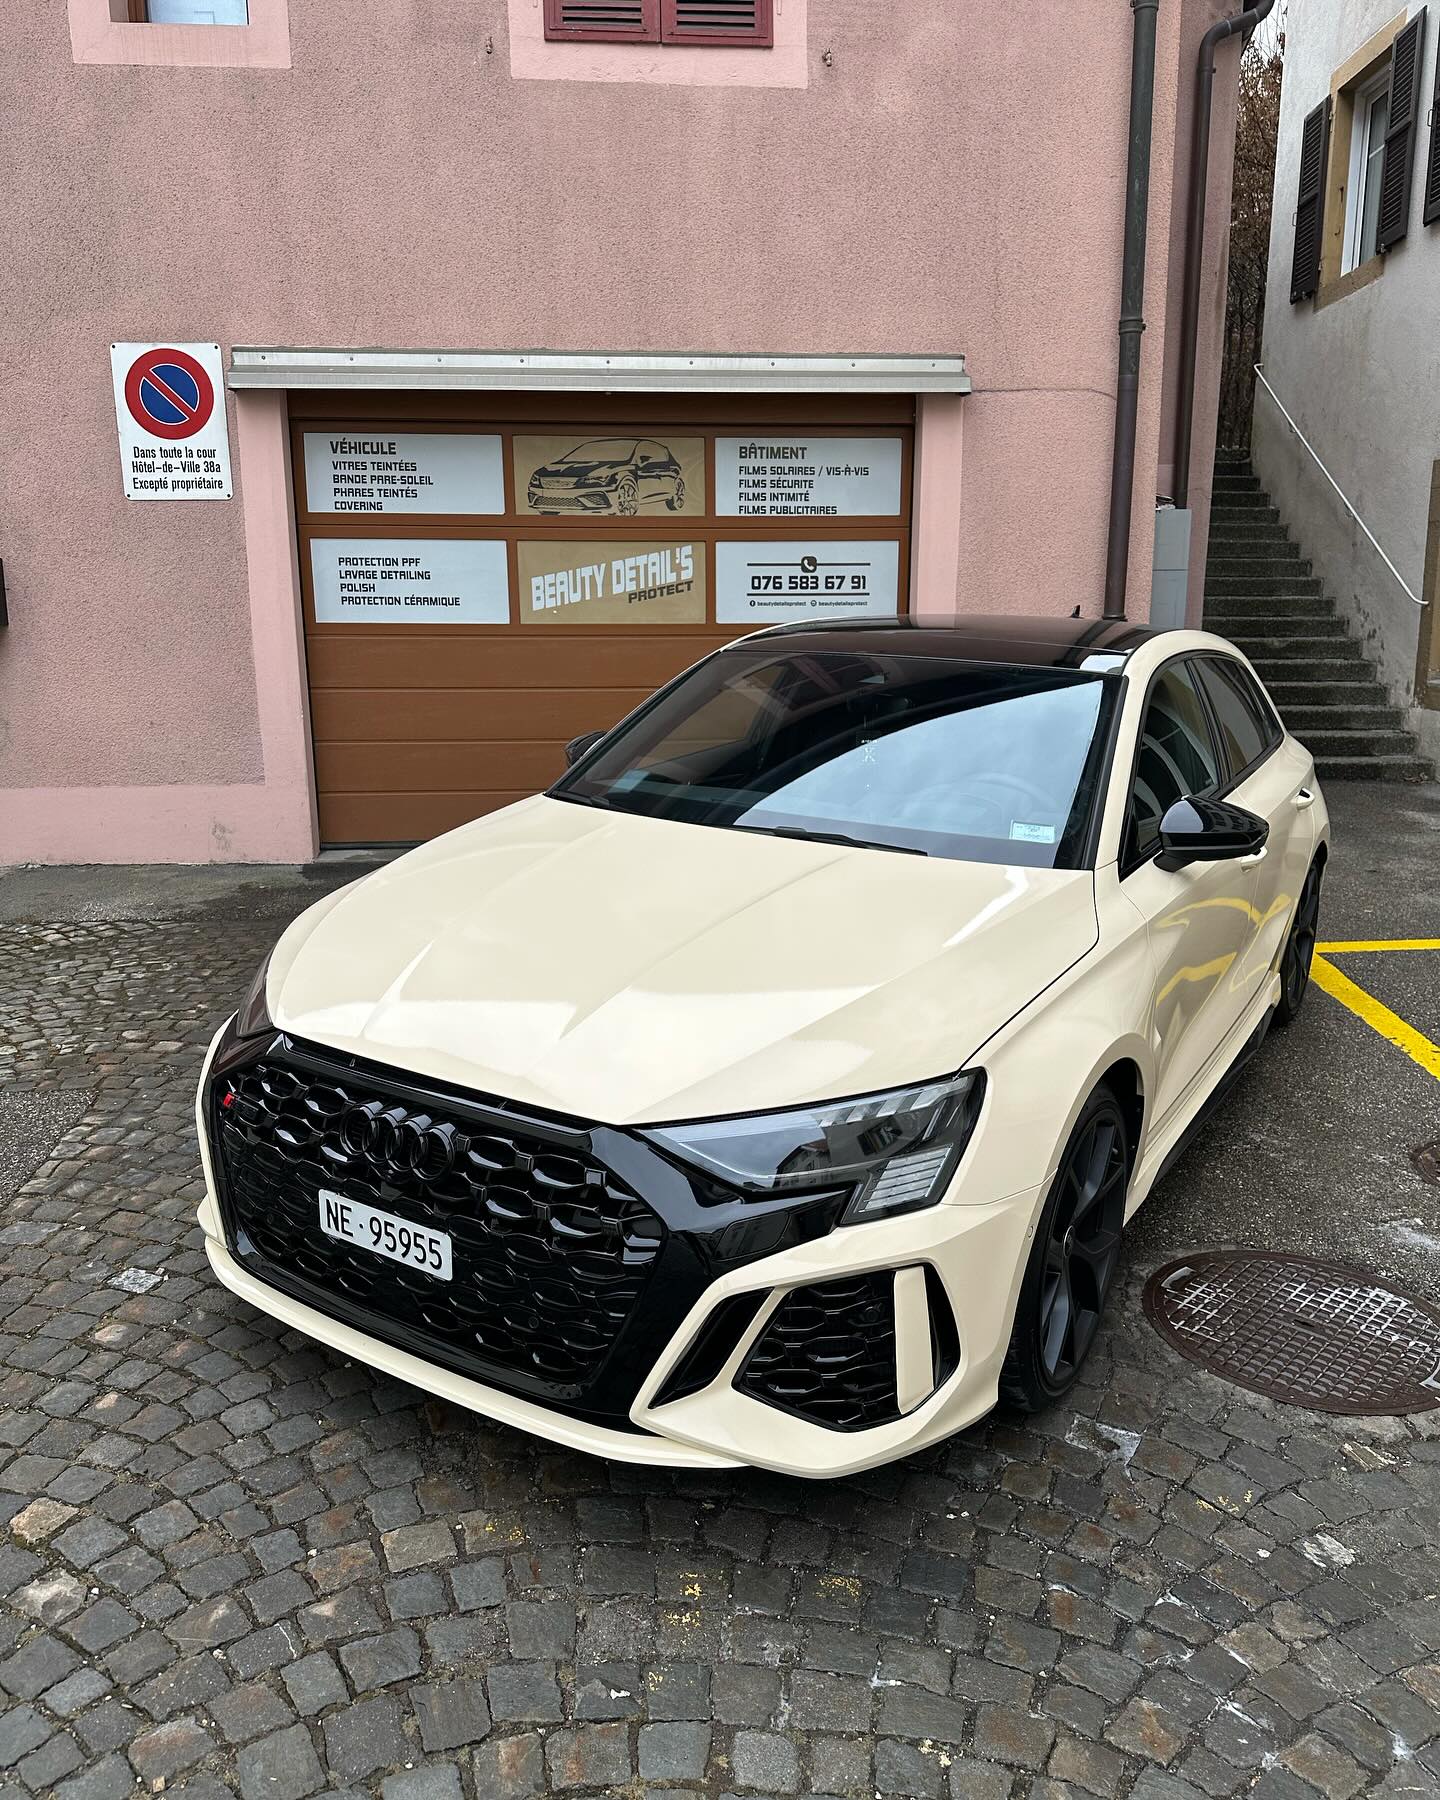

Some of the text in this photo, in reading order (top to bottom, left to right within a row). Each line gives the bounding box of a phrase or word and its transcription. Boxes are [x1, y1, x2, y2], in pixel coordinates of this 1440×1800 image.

[330, 437, 397, 455] VÉHICULE
[739, 443, 807, 459] BÂTIMENT
[133, 446, 216, 459] Dans toute la cour
[132, 461, 221, 473] Hôtel-de-Ville 38a
[332, 460, 417, 471] VITRES TEINTÉES
[739, 466, 767, 475] FILMS
[770, 466, 815, 475] SOLAIRES
[826, 464, 869, 476] VIS-À-VIS
[133, 477, 223, 492] Excepté propriétaire
[333, 474, 433, 485] BANDE PARE-SOLEIL
[739, 477, 814, 489] FILMS SÉCURITE
[333, 486, 418, 498] PHARES TEINTÉS
[739, 490, 810, 502] FILMS INTIMITÉ
[334, 501, 383, 511] COVERING
[739, 505, 837, 515] FILMS PUBLICITAIRES
[338, 557, 420, 567] PROTECTION PPF
[339, 570, 431, 580] LAVAGE DETAILING
[531, 544, 693, 611] BEAUTY DETAIL'S
[340, 583, 376, 592] POLISH
[751, 575, 866, 589] 076 583 67 91
[628, 581, 694, 603] PROTECT
[341, 594, 460, 607] PROTECTION CÉRAMIQUE
